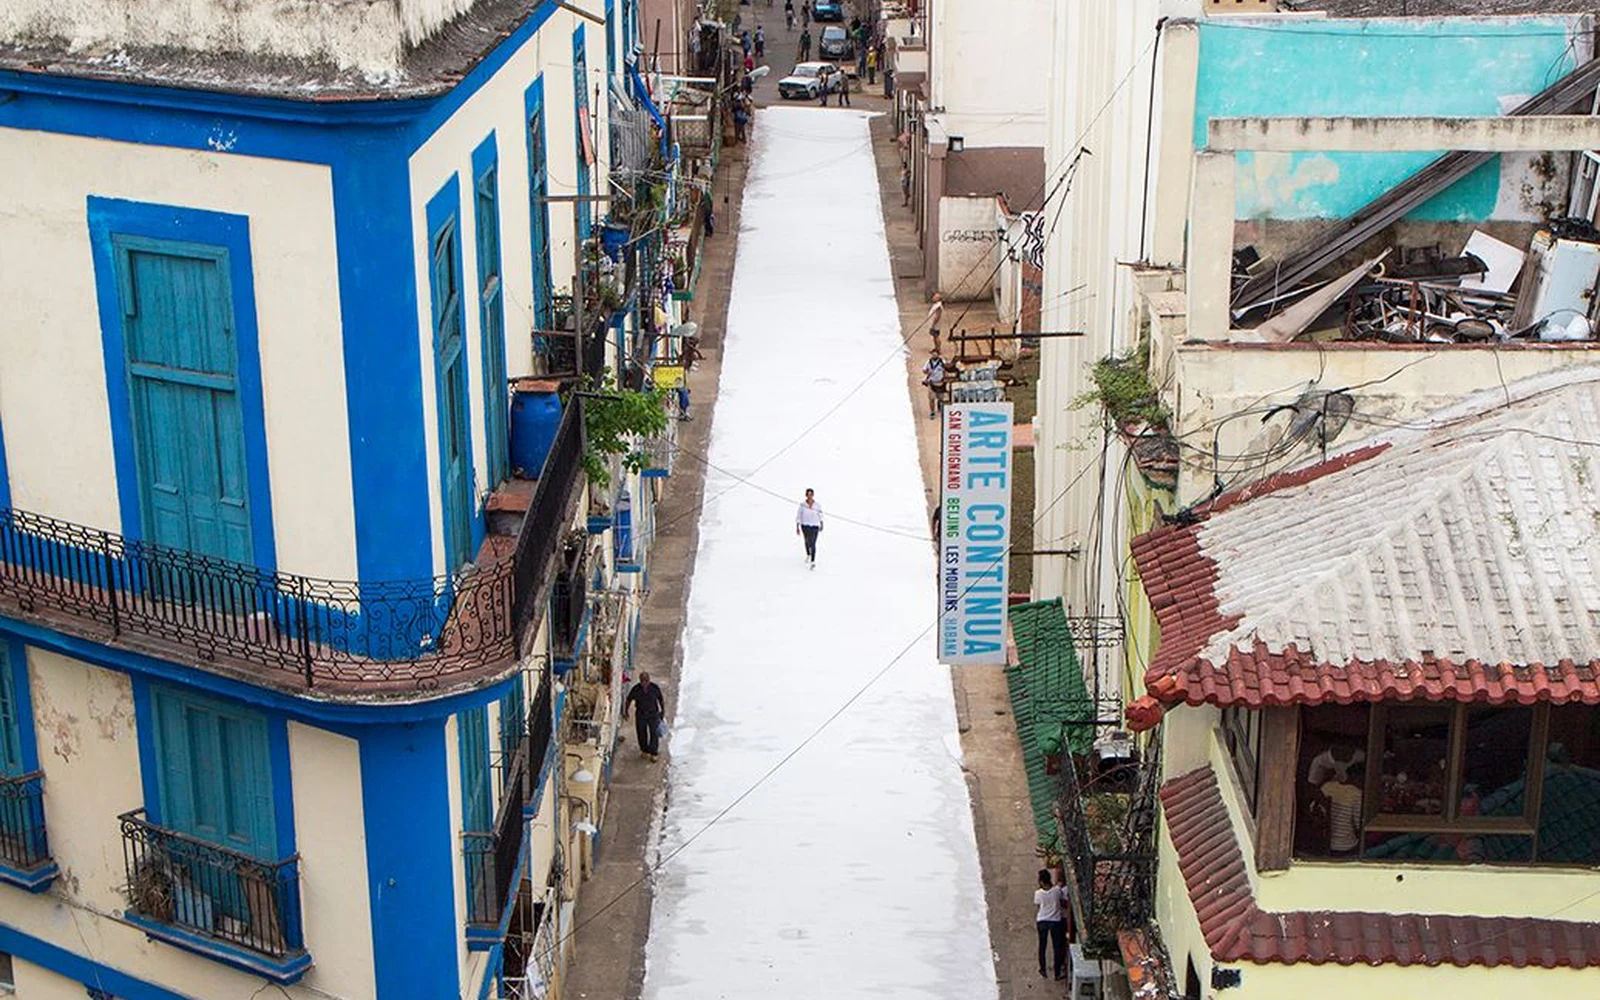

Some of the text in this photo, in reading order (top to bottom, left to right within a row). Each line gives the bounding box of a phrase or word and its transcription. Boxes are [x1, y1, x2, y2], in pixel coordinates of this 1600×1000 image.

[944, 410, 962, 656] SAN GIMIGNANO BEIJING LES MOULINS HABANA
[964, 411, 1007, 655] ARTE CONTINUA
